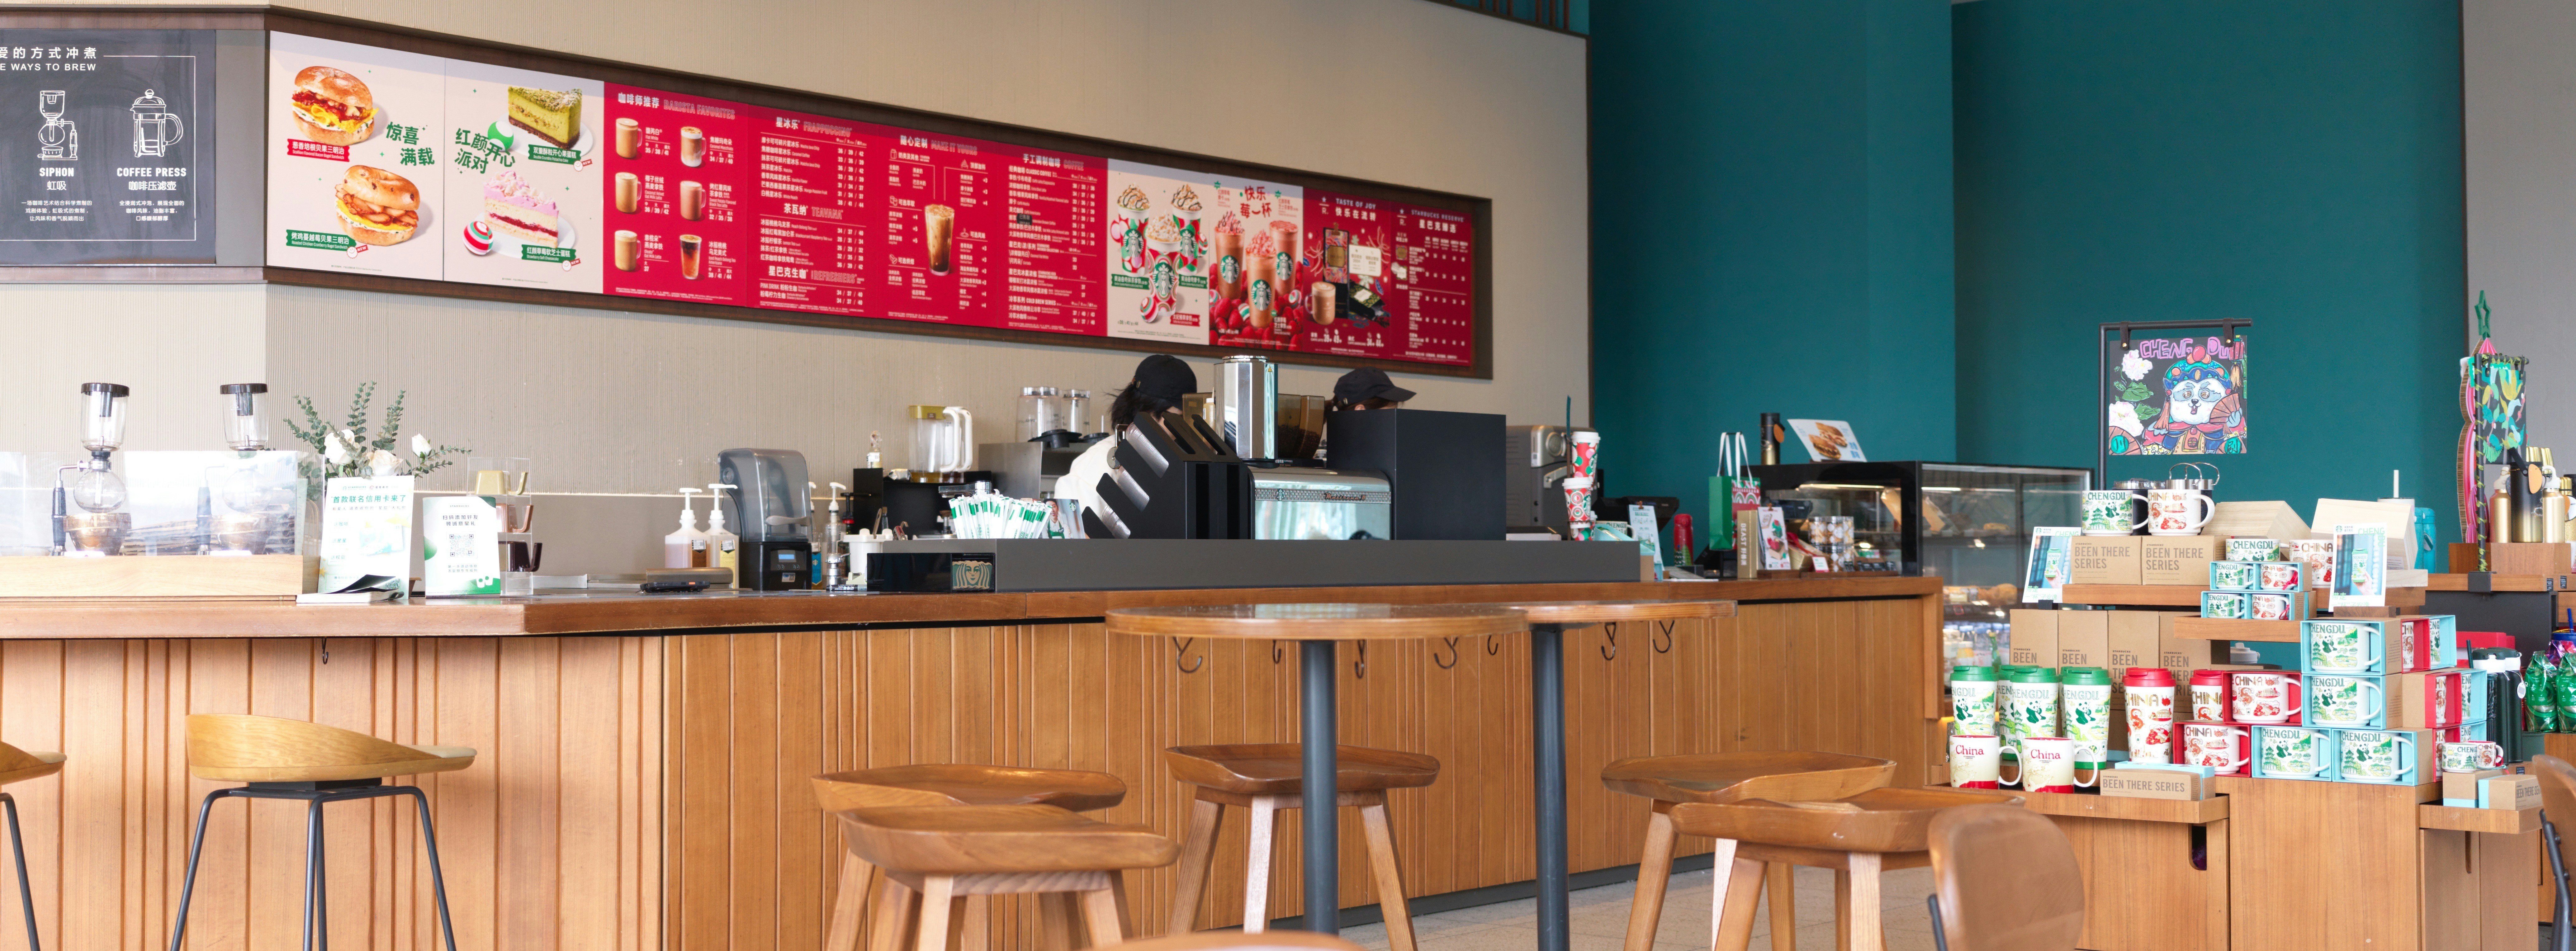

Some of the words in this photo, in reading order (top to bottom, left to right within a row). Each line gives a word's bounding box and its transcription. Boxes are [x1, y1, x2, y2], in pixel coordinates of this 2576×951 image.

[0, 47, 97, 59] 爱的方式冲煮
[618, 92, 659, 109] 咖啡师推荐
[664, 99, 695, 114] BARISTA
[697, 104, 735, 120] FAVORITES
[386, 122, 419, 145] 惊喜
[292, 141, 344, 155] 葱香培根贝果三明治
[455, 128, 515, 168] 红颜开心
[900, 135, 928, 149] 随心定制
[957, 144, 978, 156] YOURS
[400, 147, 435, 166] 满载
[454, 149, 489, 174] 派对
[1023, 154, 1060, 168] 手工调制咖啡
[40, 168, 74, 177] SIPHON
[117, 168, 152, 177] COFFEE
[156, 168, 186, 177] PRESS
[47, 181, 66, 190] 虹吸
[129, 181, 176, 191] 咖啡压滤壶
[1244, 186, 1266, 201] 快乐
[1336, 198, 1353, 206] TASTE
[1411, 209, 1440, 219] STARBUCKS
[1441, 214, 1464, 222] RESERVE
[291, 232, 349, 244] 烤鸡蔓越莓贝果三明治
[527, 247, 570, 257] 红颜草莓软芝士蛋糕
[2140, 338, 2193, 359] CHENG
[334, 495, 406, 503] 首款联名信用卡来了
[2088, 492, 2126, 500] CHENGDU
[2358, 527, 2385, 536] CHENG
[2233, 541, 2273, 549] CHENGDU
[2302, 543, 2333, 552] CHINA
[2075, 547, 2098, 557] BEEN
[2101, 547, 2130, 557] THERE
[2146, 548, 2170, 558] BEEN
[2174, 548, 2203, 558] THERE
[2075, 558, 2107, 569] SERIES
[2146, 560, 2179, 570] SERIES
[2311, 624, 2346, 634] CHENGDU
[2013, 652, 2037, 664] BEEN
[2062, 654, 2087, 665] BEEN
[2112, 654, 2138, 666] BEEN
[2164, 656, 2189, 667] BEEN
[2235, 676, 2263, 686] CHINA
[2185, 726, 2212, 737] CHINA
[2262, 728, 2300, 740] CHENGDU
[2342, 731, 2382, 742] CHENGDU
[1956, 745, 1984, 755] China
[2030, 749, 2061, 759] China
[2103, 779, 2124, 789] BEEN
[2127, 780, 2152, 791] THERE
[2155, 781, 2185, 792] SERIES
[2525, 786, 2534, 797] THERE
